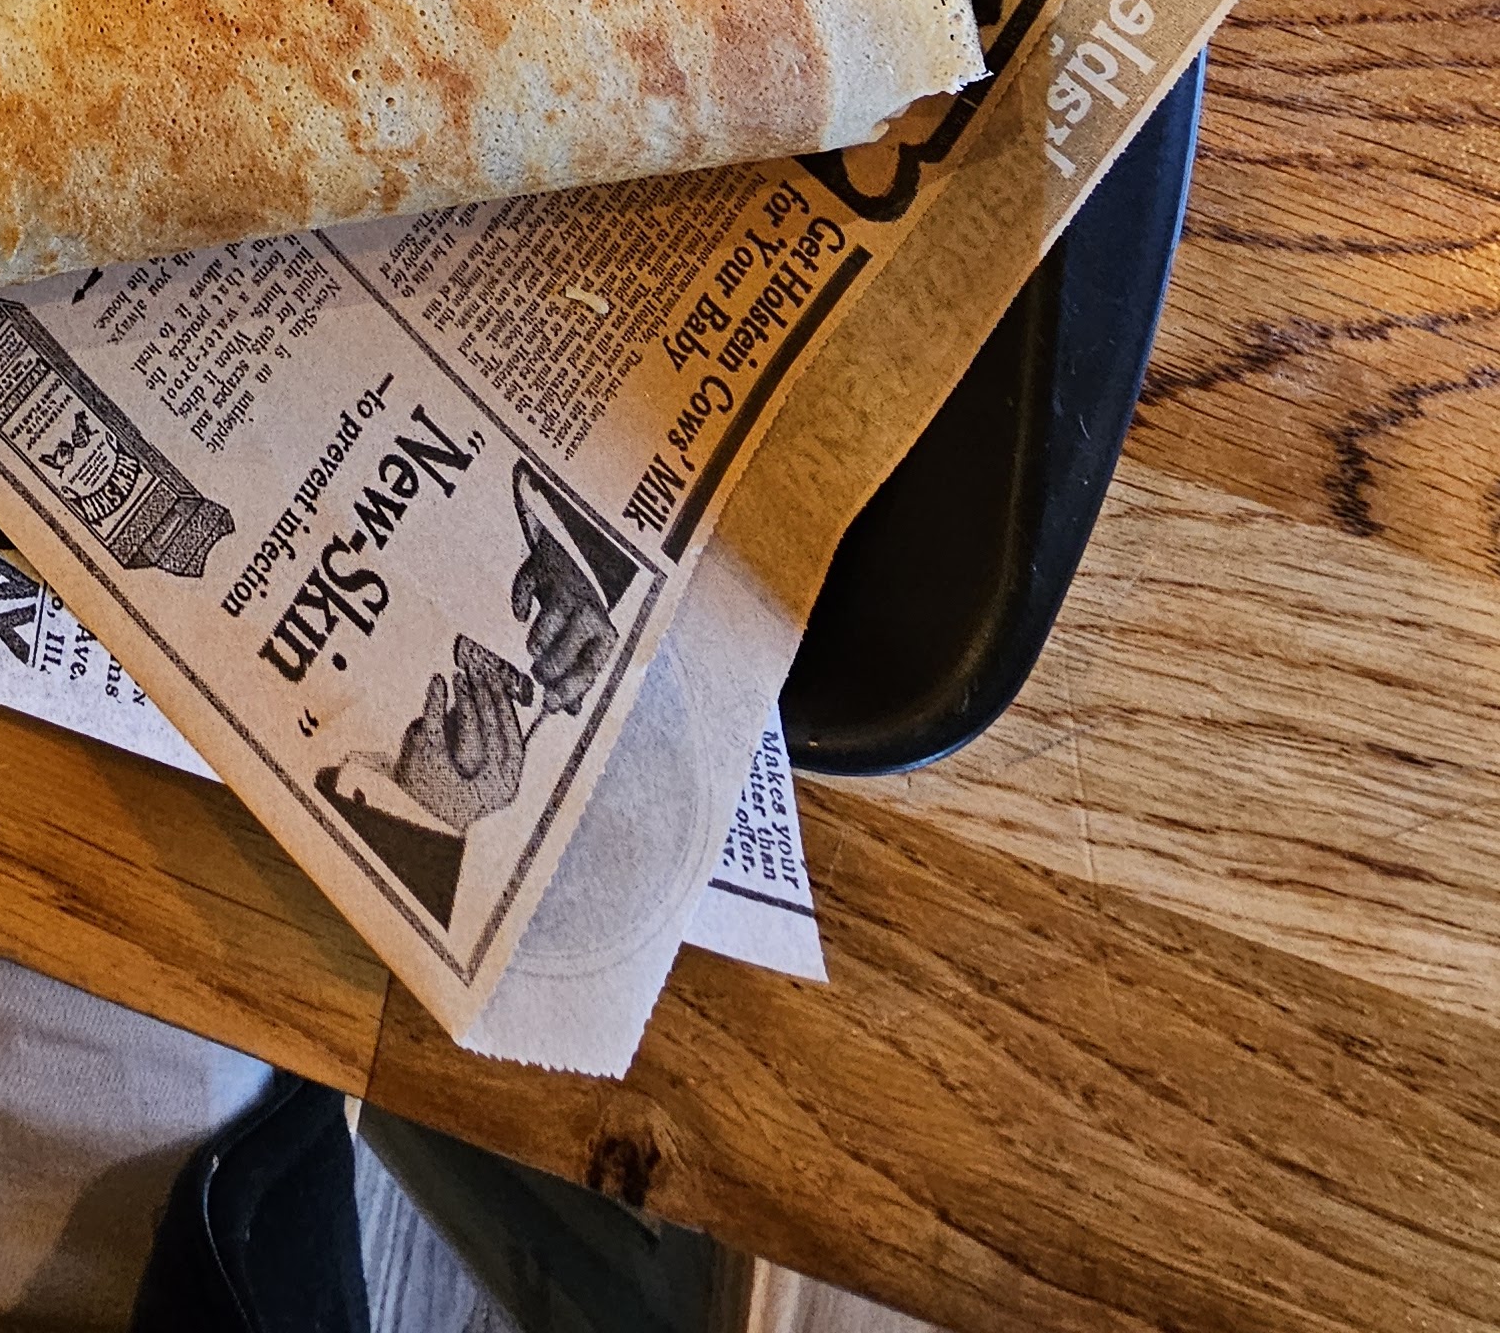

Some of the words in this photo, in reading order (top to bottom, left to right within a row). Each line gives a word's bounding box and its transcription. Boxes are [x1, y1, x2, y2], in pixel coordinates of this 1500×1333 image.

[762, 177, 810, 229] for
[789, 215, 846, 273] Get
[714, 227, 788, 299] Your
[662, 291, 733, 374] Baby
[716, 260, 814, 373] Holstein
[293, 410, 363, 516] prevent
[667, 374, 734, 472] Cows'
[621, 452, 699, 534] Milk
[220, 507, 311, 618] infection
[764, 730, 787, 816] Makes
[771, 821, 800, 890] your
